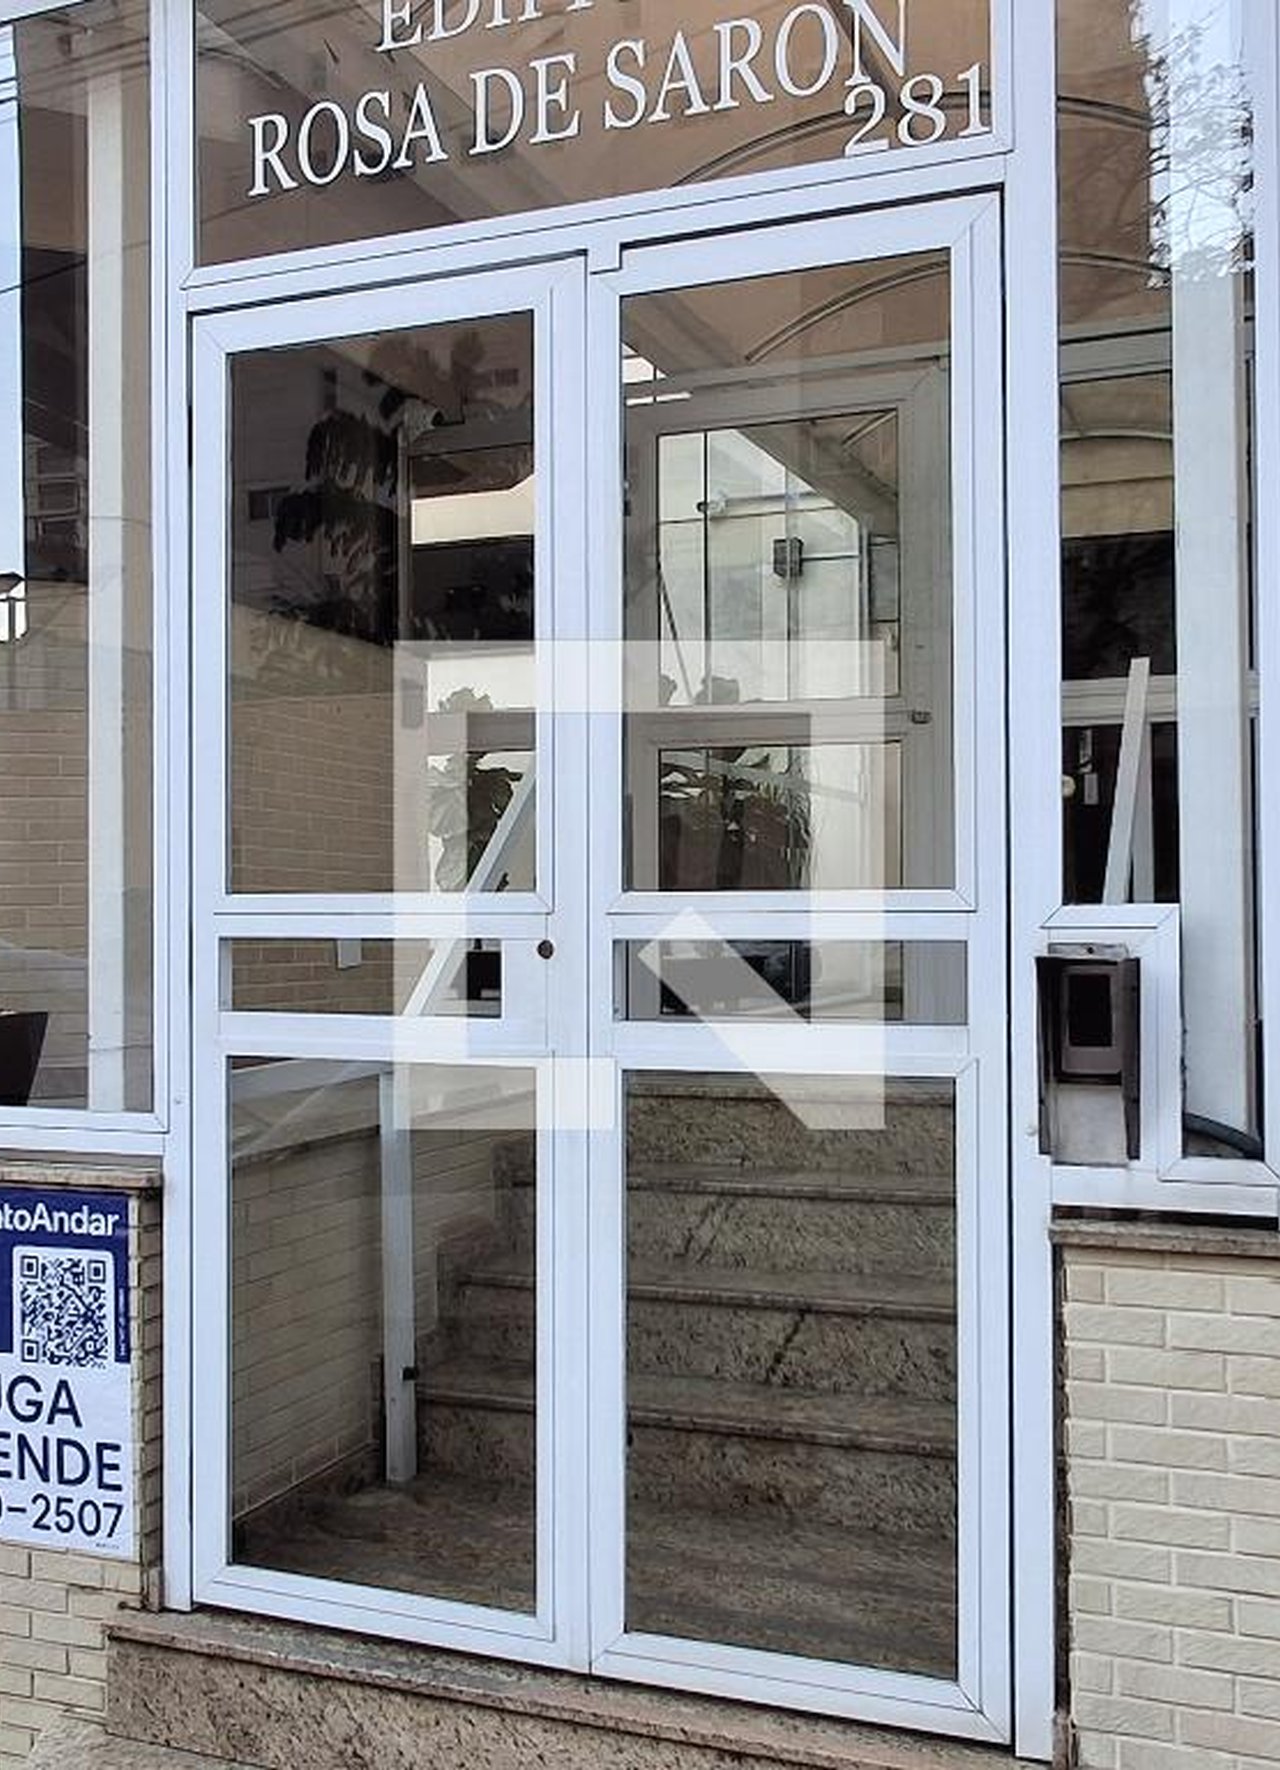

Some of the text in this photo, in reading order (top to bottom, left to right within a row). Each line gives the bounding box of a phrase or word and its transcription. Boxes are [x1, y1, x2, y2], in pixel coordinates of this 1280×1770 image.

[247, 82, 448, 198] ROSA
[469, 52, 582, 157] DE
[603, 0, 906, 132] SARON
[844, 61, 992, 157] 281
